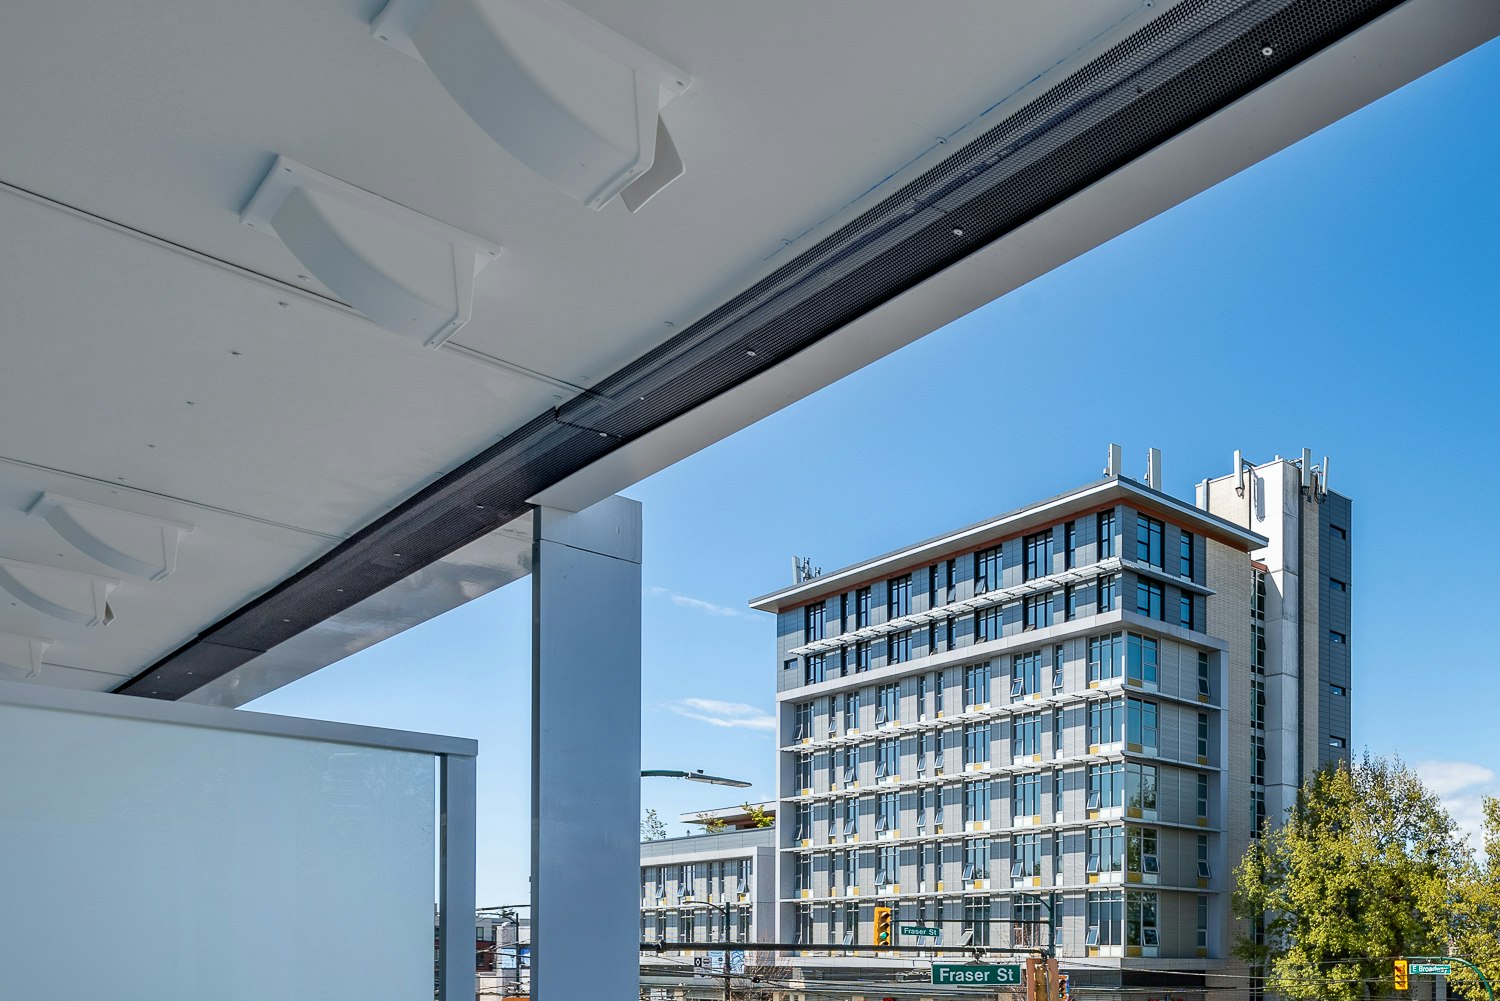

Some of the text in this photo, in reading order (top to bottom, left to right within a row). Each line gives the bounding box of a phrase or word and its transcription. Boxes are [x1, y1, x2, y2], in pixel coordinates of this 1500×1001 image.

[904, 927, 926, 935] Fraser
[939, 968, 1014, 982] Fraser St
